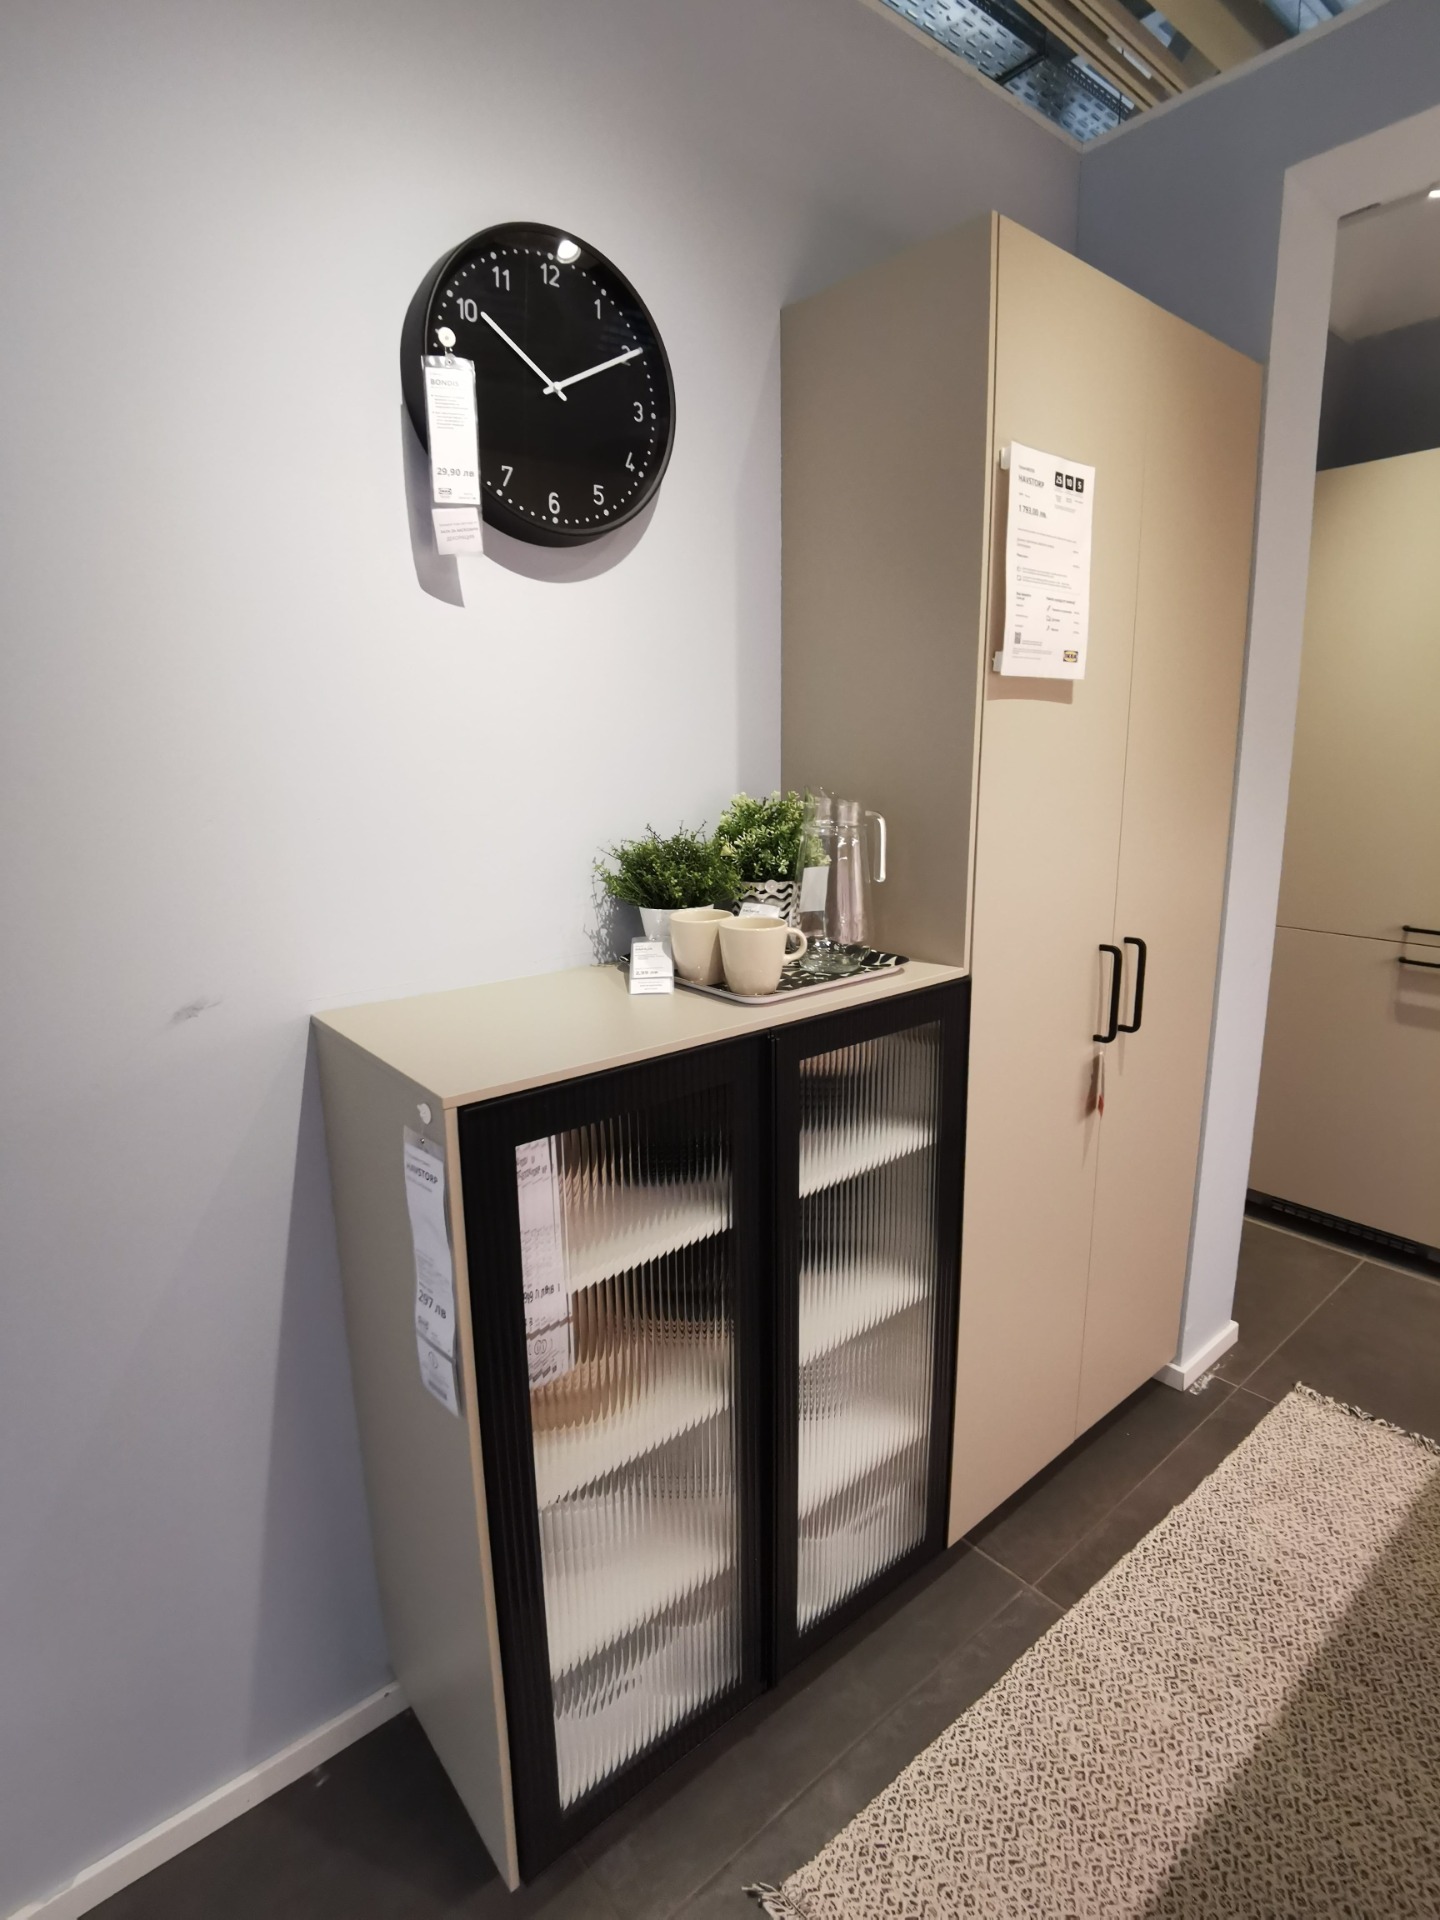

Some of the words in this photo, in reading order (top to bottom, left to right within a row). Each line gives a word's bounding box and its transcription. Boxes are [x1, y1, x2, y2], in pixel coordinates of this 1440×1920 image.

[492, 266, 510, 291] 11
[540, 263, 560, 288] 12
[456, 298, 478, 322] 10
[594, 299, 601, 320] 1
[430, 378, 460, 387] BONDIS
[633, 401, 644, 423] 3
[436, 467, 461, 477] 29,90
[625, 452, 635, 472] 4
[501, 465, 513, 487] 7
[548, 492, 560, 515] 6
[593, 484, 605, 506] 5
[418, 1289, 434, 1309] 297
